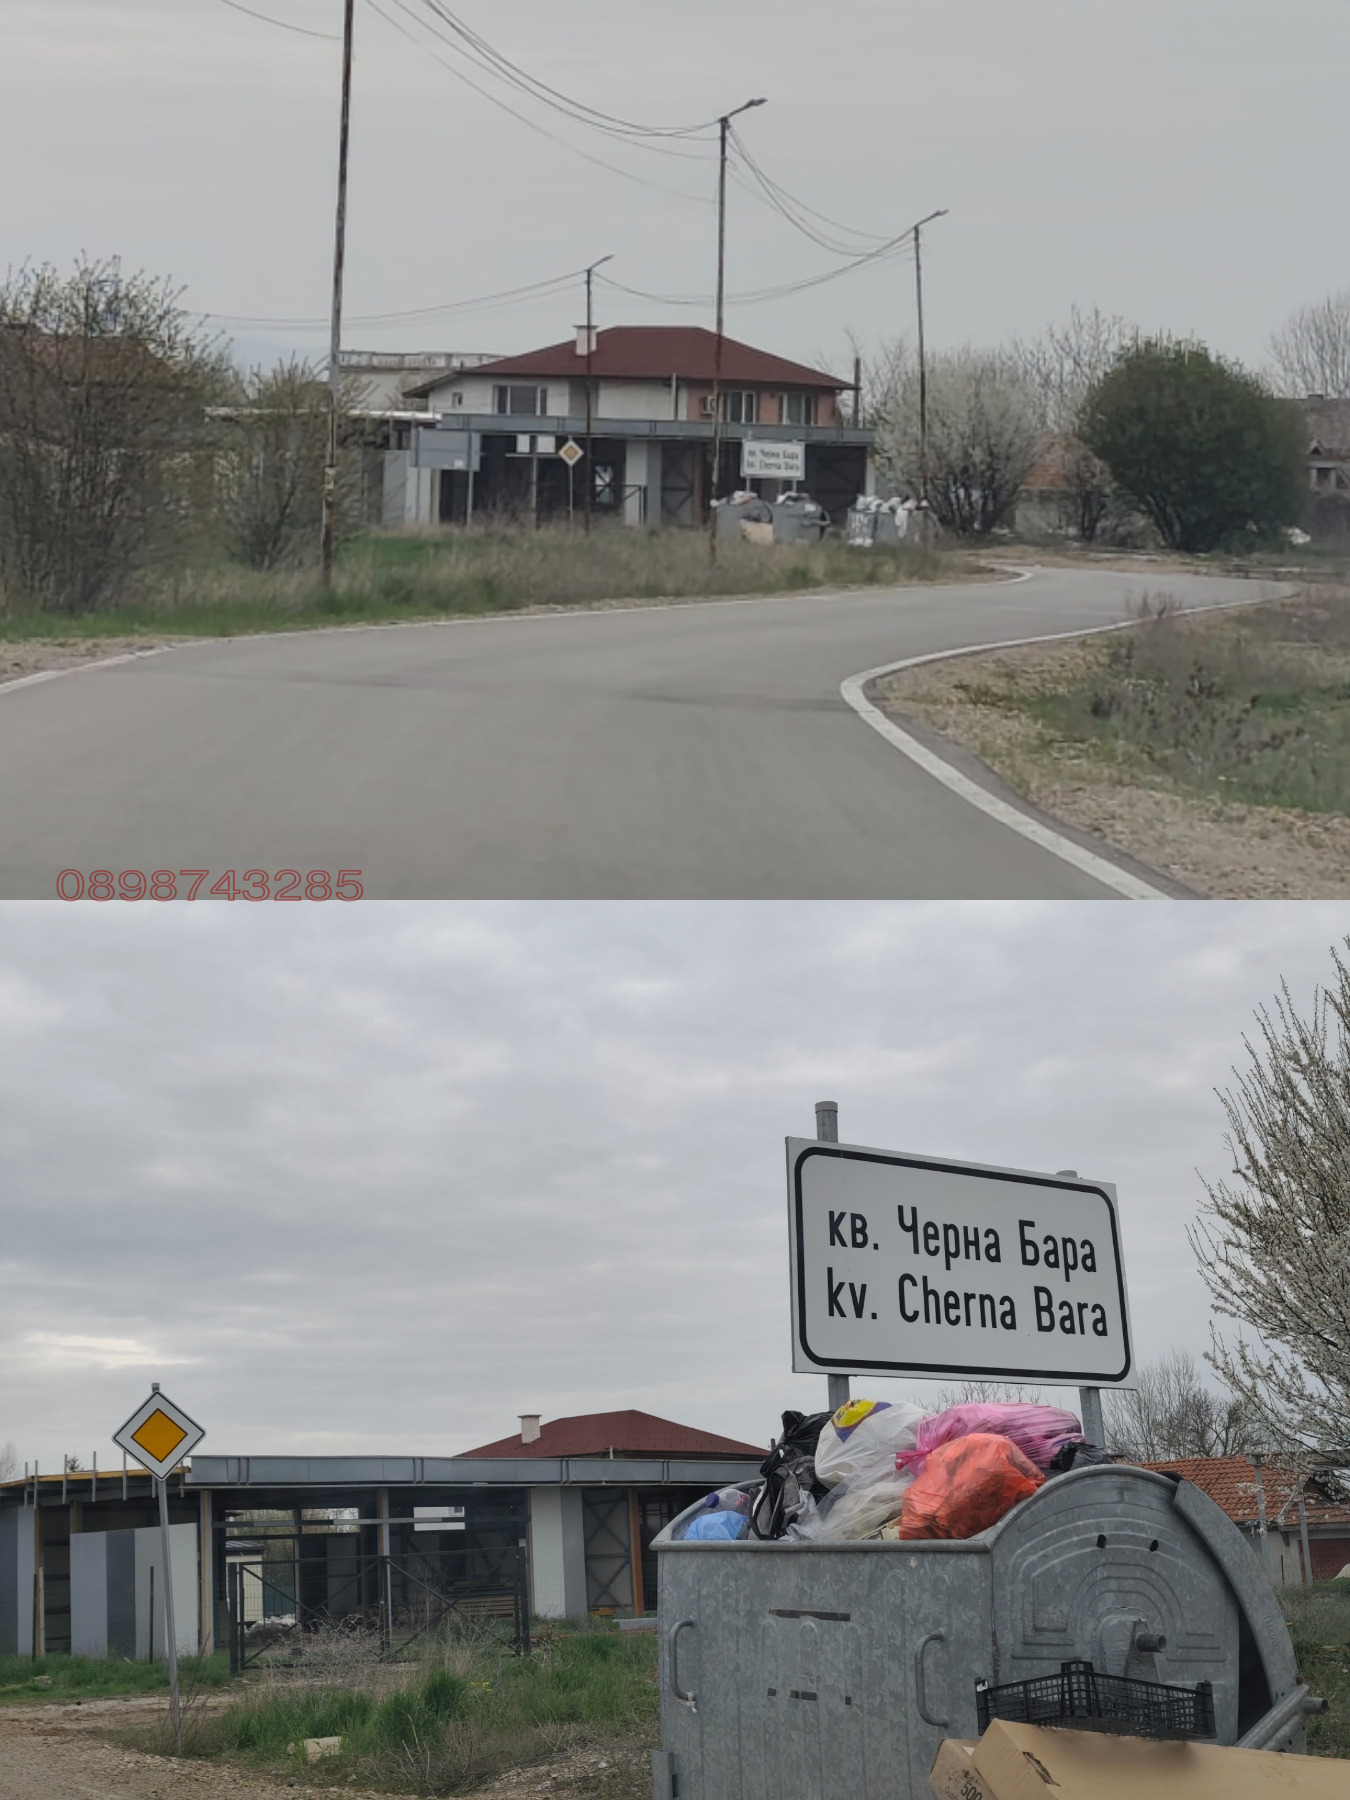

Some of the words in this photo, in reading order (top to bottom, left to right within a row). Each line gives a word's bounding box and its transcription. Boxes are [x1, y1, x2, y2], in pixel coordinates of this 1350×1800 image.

[828, 1210, 879, 1250] кв.
[897, 1204, 1002, 1271] Черна
[1018, 1219, 1098, 1282] Бара
[826, 1266, 878, 1320] kv.
[898, 1272, 1017, 1330] Cherna
[1033, 1285, 1109, 1338] Bara
